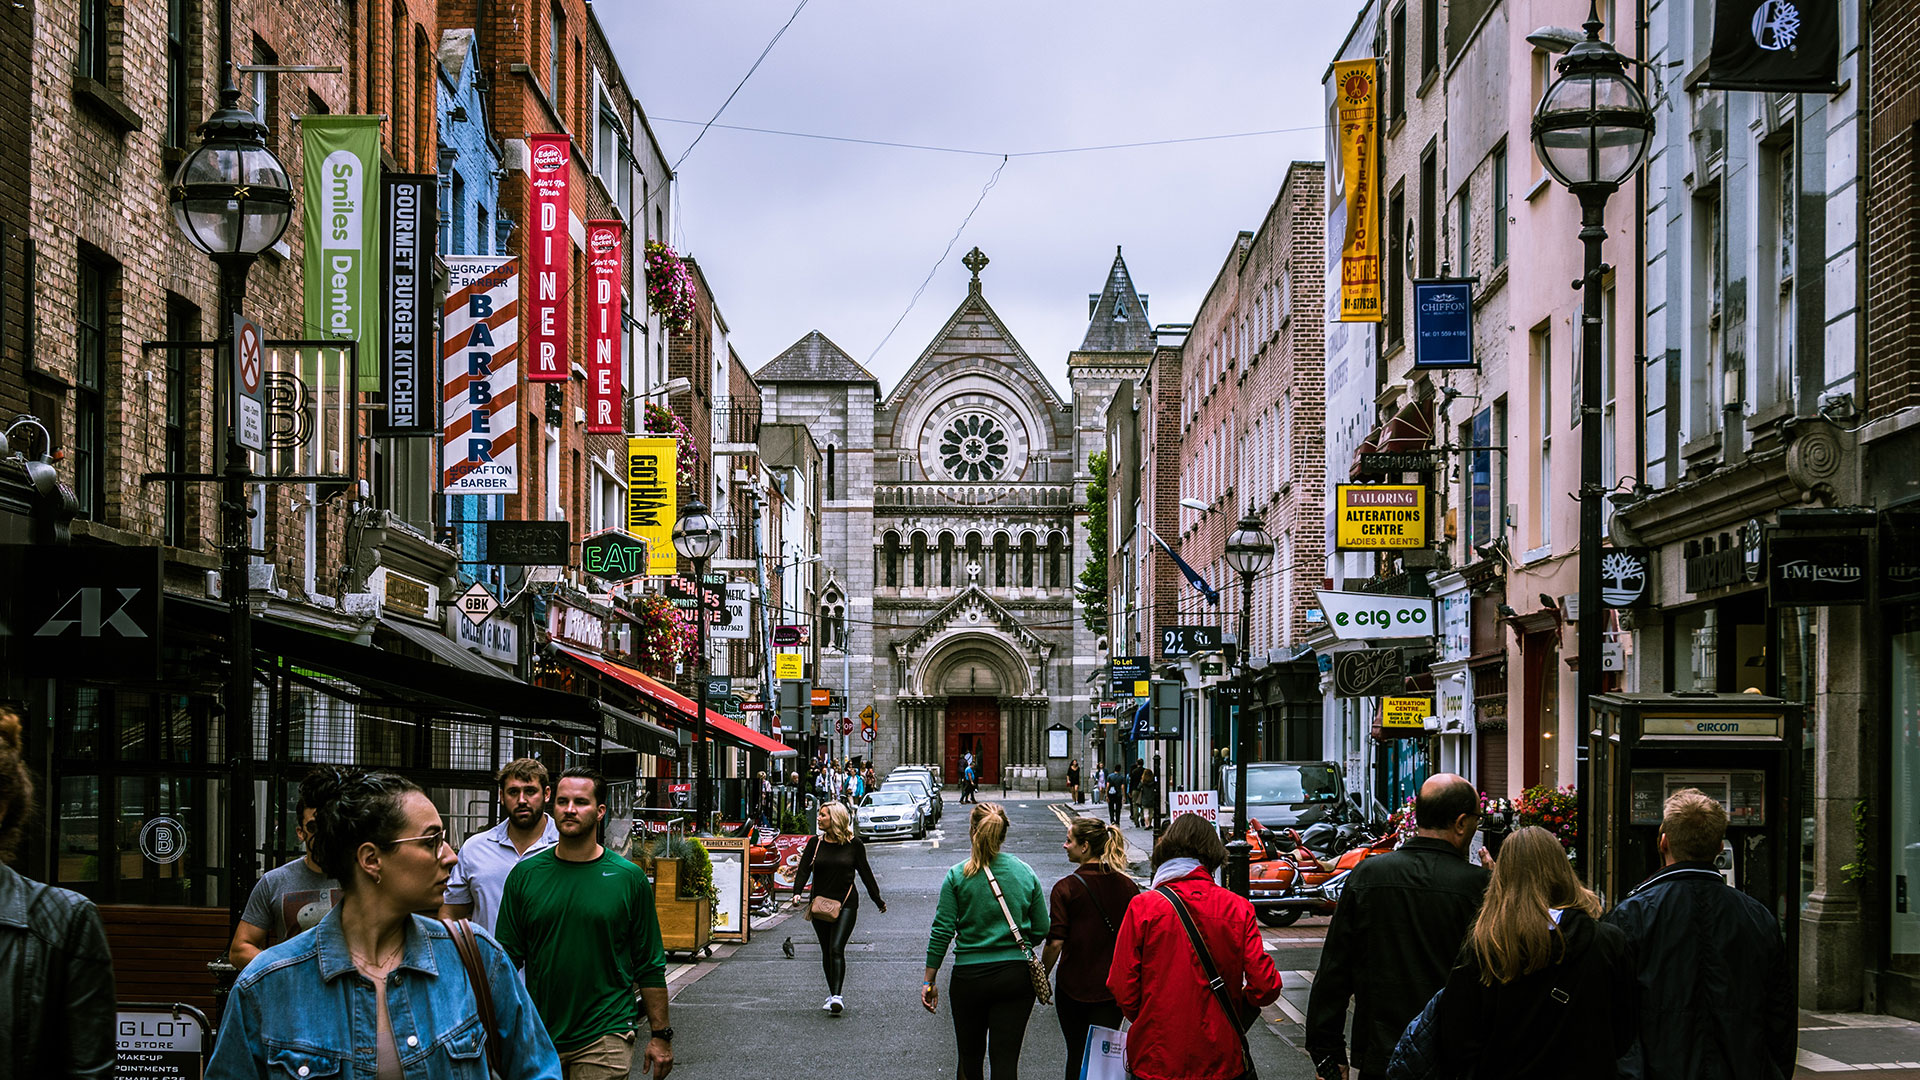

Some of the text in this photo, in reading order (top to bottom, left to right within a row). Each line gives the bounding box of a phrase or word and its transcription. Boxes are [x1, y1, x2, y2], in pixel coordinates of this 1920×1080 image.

[554, 179, 566, 187] No
[1354, 134, 1367, 251] ALTERATION
[332, 163, 354, 241] Smiles
[450, 264, 460, 286] THE
[460, 264, 513, 275] GRAFTON
[1344, 259, 1377, 281] CENTRE
[461, 277, 508, 288] BARBER
[539, 203, 557, 371] DINER
[331, 255, 353, 340] Dental
[393, 184, 415, 428] GOURMET BURGER KITCHEN
[1421, 303, 1465, 311] CHIFFON
[597, 279, 612, 425] DINER
[467, 294, 495, 462] BARBER
[449, 465, 459, 487] THE
[459, 465, 512, 475] GRAFTON
[461, 478, 508, 488] BARBER
[631, 455, 672, 527] GOTHAM
[1352, 493, 1413, 504] TAILORING
[1346, 510, 1420, 521] ALTERATIONS
[495, 528, 563, 541] GRAFTON
[1362, 524, 1404, 535] CENTRE
[1346, 537, 1377, 545] LADIES
[1386, 537, 1420, 545] GENTS
[500, 544, 558, 556] BARBER
[586, 543, 641, 573] EAT
[695, 575, 724, 584] INES
[466, 598, 489, 610] GBK
[671, 598, 698, 607] SPIRITS
[33, 587, 149, 638] AK
[1335, 611, 1349, 627] e
[1355, 609, 1391, 630] cig
[1396, 607, 1427, 624] co
[502, 627, 511, 653] SIX
[1164, 631, 1189, 654] 22
[709, 683, 728, 693] SO
[1177, 793, 1209, 806] DO NOT
[1172, 809, 1217, 820] RE THIS
[155, 827, 174, 854] B
[119, 1021, 192, 1037] GLOT
